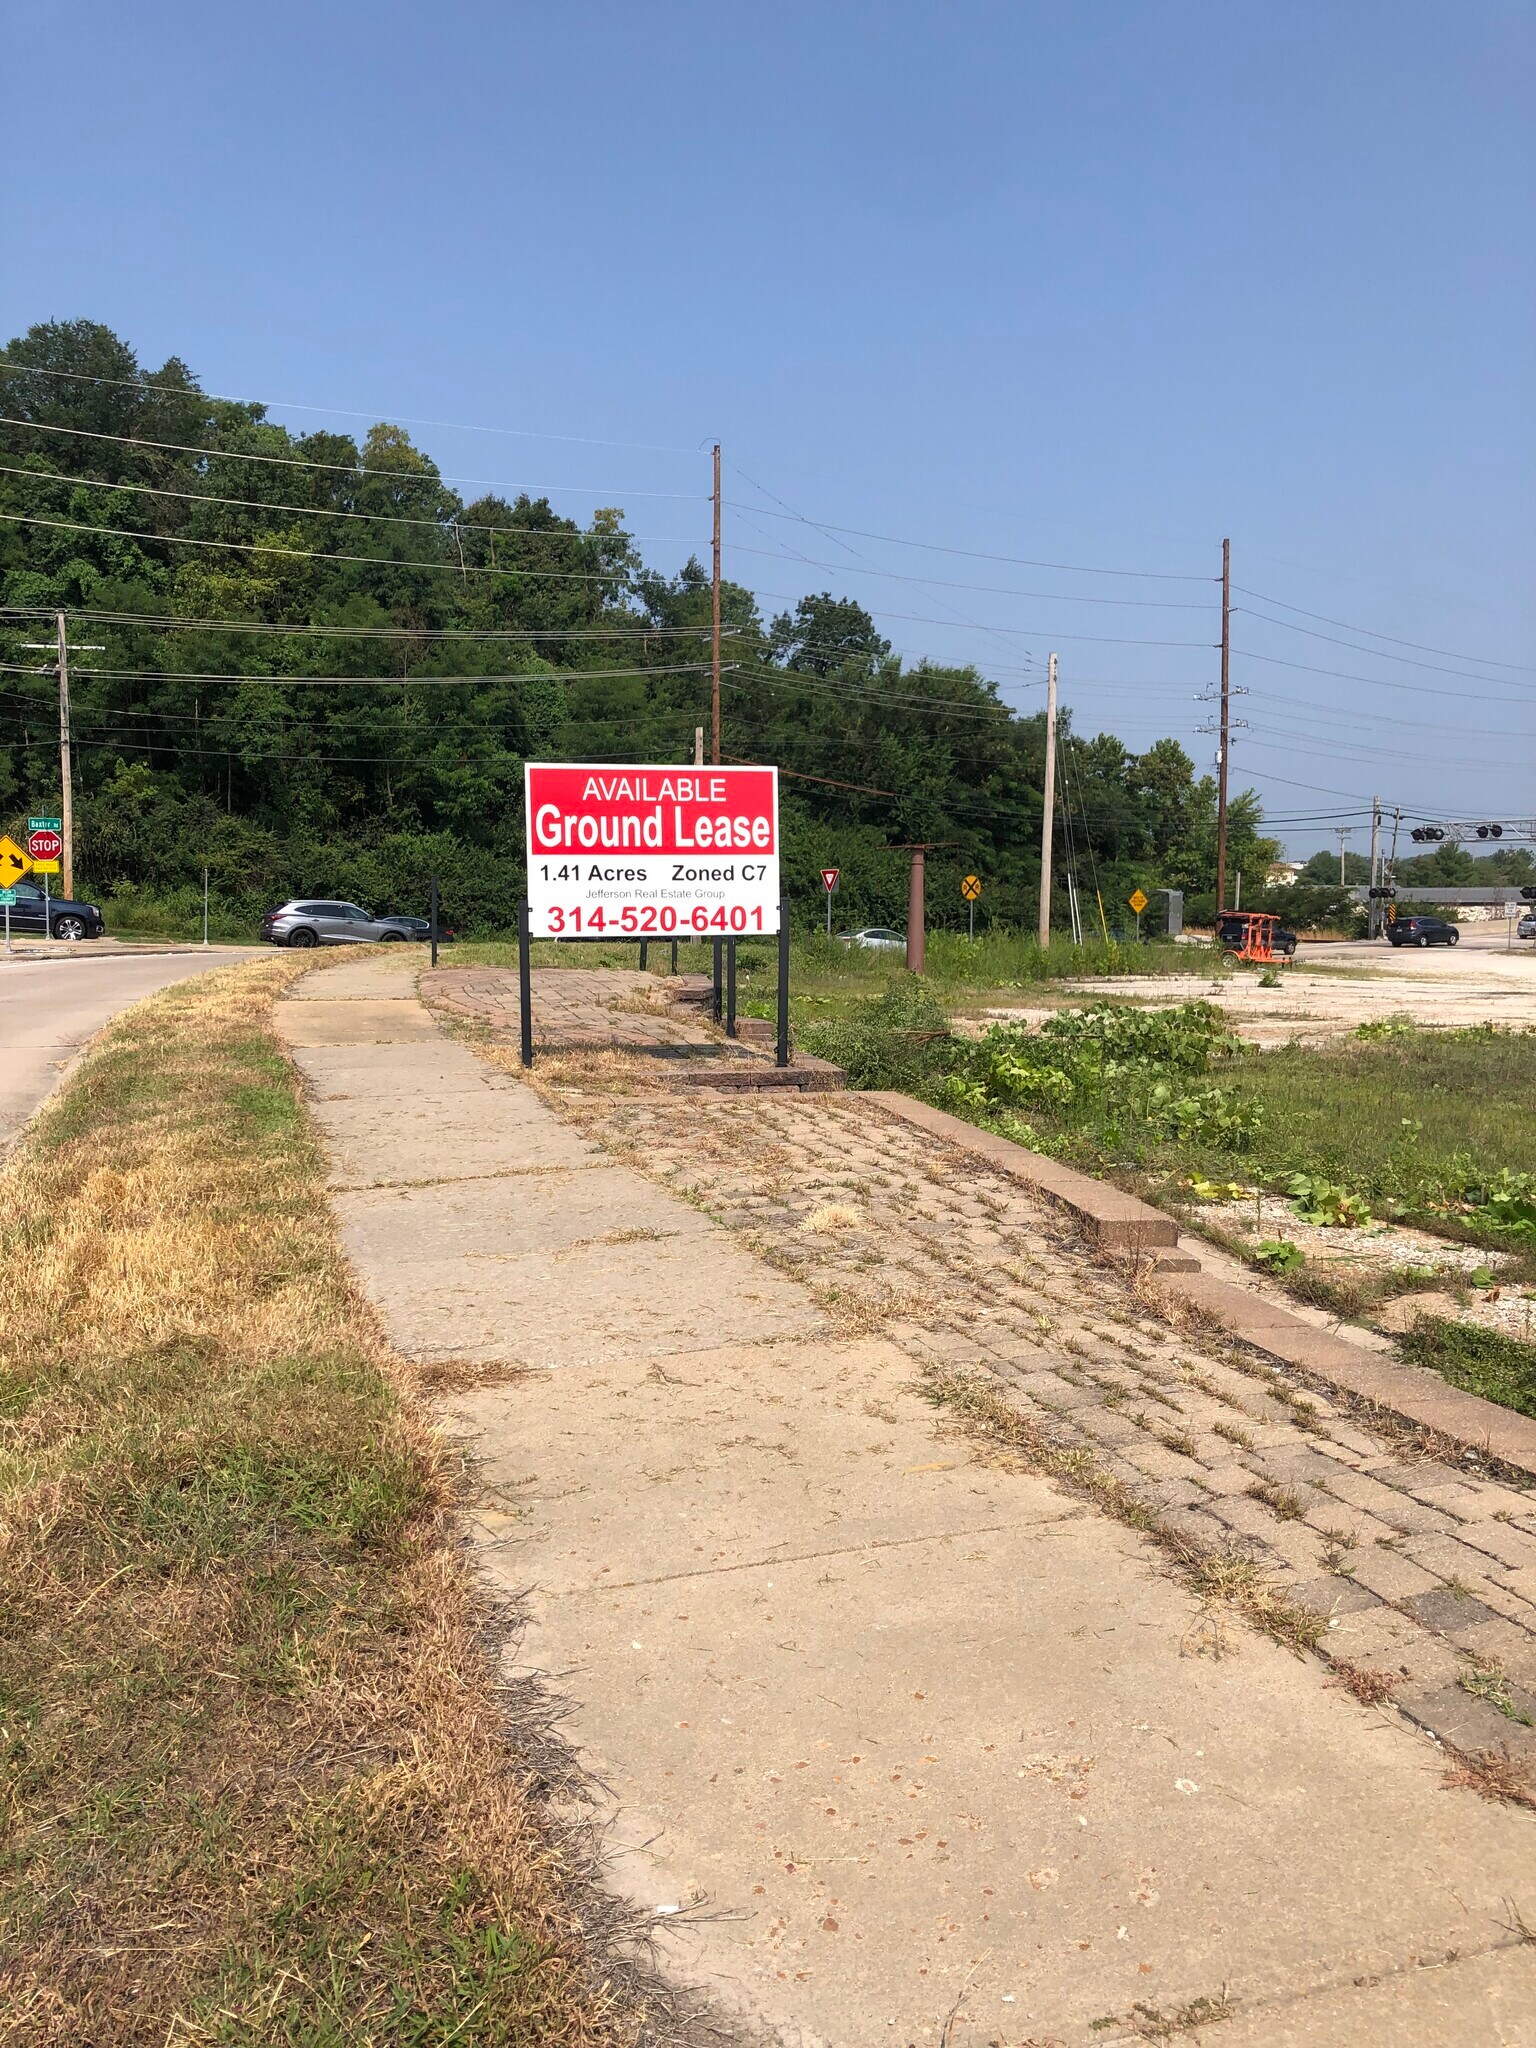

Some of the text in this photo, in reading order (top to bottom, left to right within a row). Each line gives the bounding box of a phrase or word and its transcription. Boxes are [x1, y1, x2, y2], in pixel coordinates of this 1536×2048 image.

[582, 777, 727, 802] AVAILABLE
[31, 820, 50, 828] Baxter
[535, 804, 771, 848] Ground Lease
[32, 840, 59, 851] STOP
[540, 864, 768, 882] 1.41 Acres Zoned C7
[585, 889, 726, 900] Jefferson Real Estate Group
[547, 905, 763, 933] 314-520-6401
